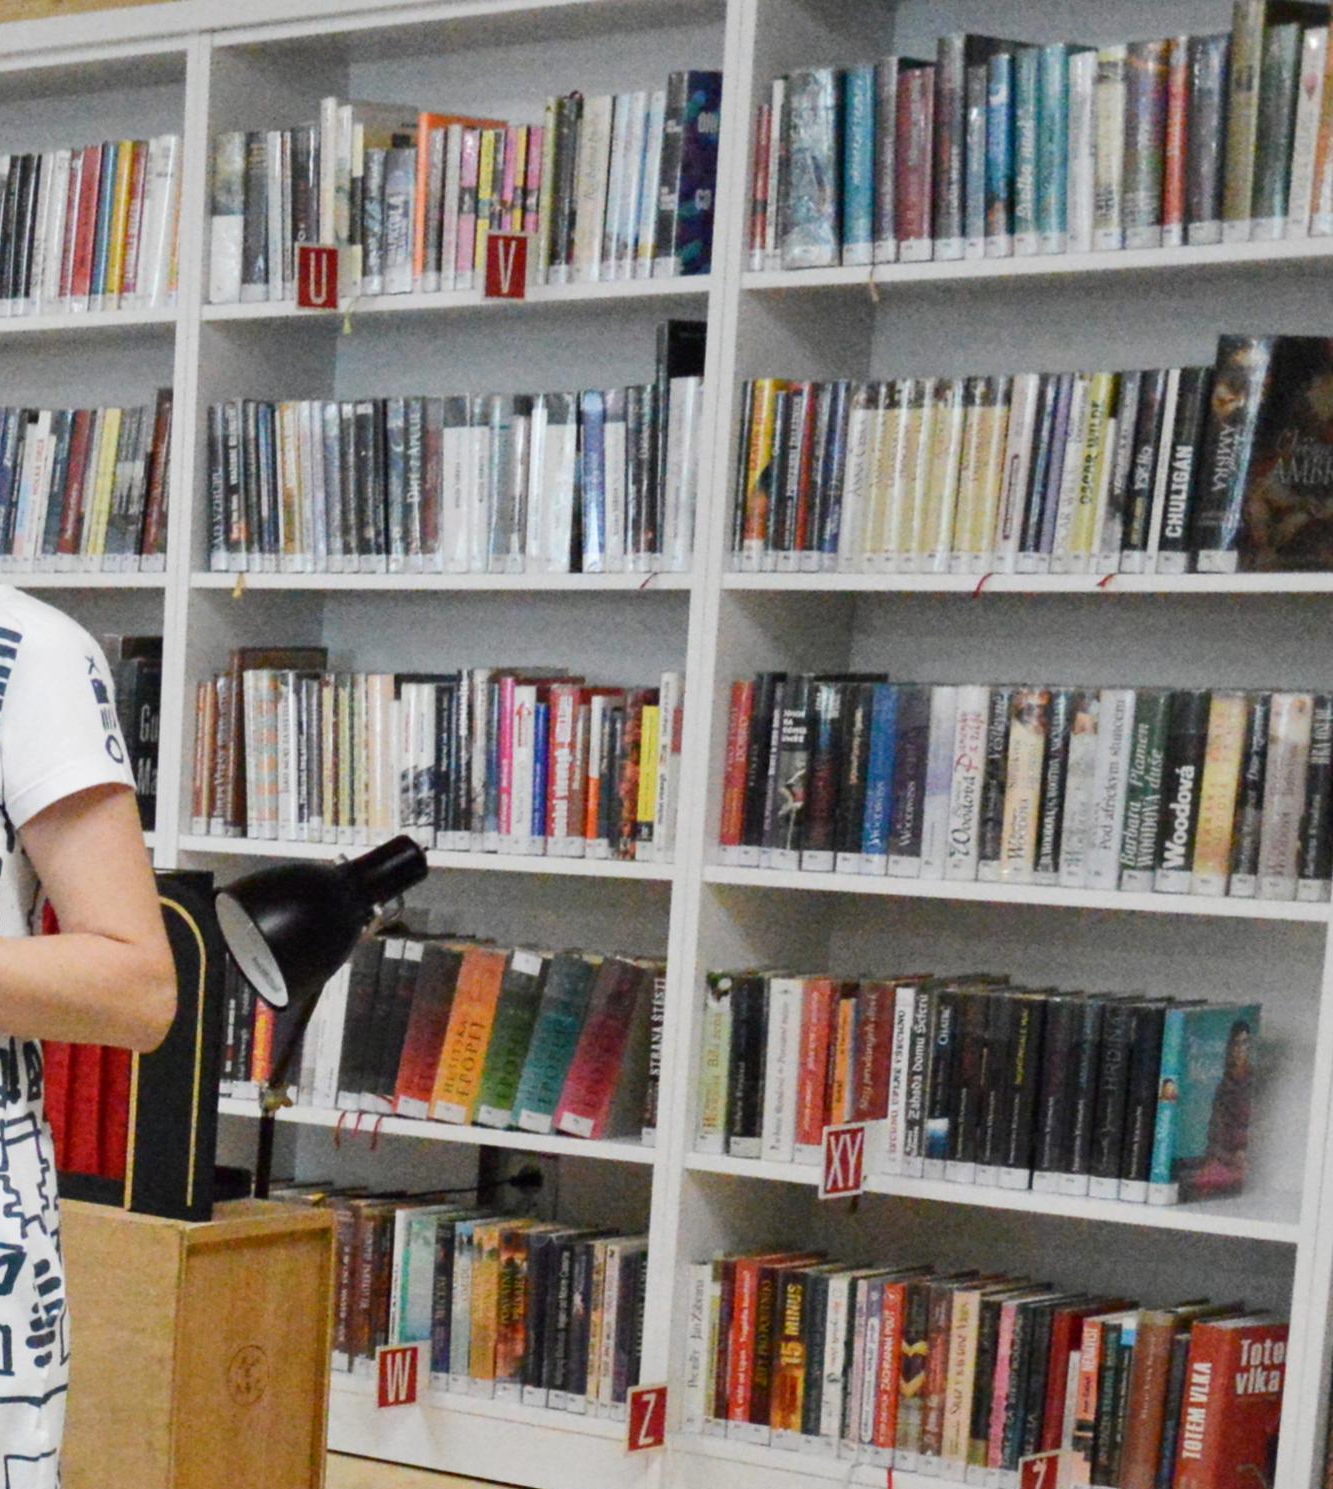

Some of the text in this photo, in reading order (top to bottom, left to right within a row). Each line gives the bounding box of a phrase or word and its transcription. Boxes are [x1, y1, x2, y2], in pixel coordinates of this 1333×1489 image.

[309, 251, 328, 305] U
[497, 238, 517, 294] V
[1164, 444, 1193, 538] CHULIGÁN
[1099, 822, 1115, 850] Pod
[1161, 764, 1195, 868] Woodová
[825, 1131, 863, 1191] XY
[779, 1284, 802, 1366] 15 MINUS
[1240, 1338, 1286, 1367] Tote
[386, 1350, 412, 1404] W
[1236, 1367, 1280, 1395] vlka
[638, 1391, 658, 1447] Z
[1183, 1362, 1212, 1459] TOTEM VLKA
